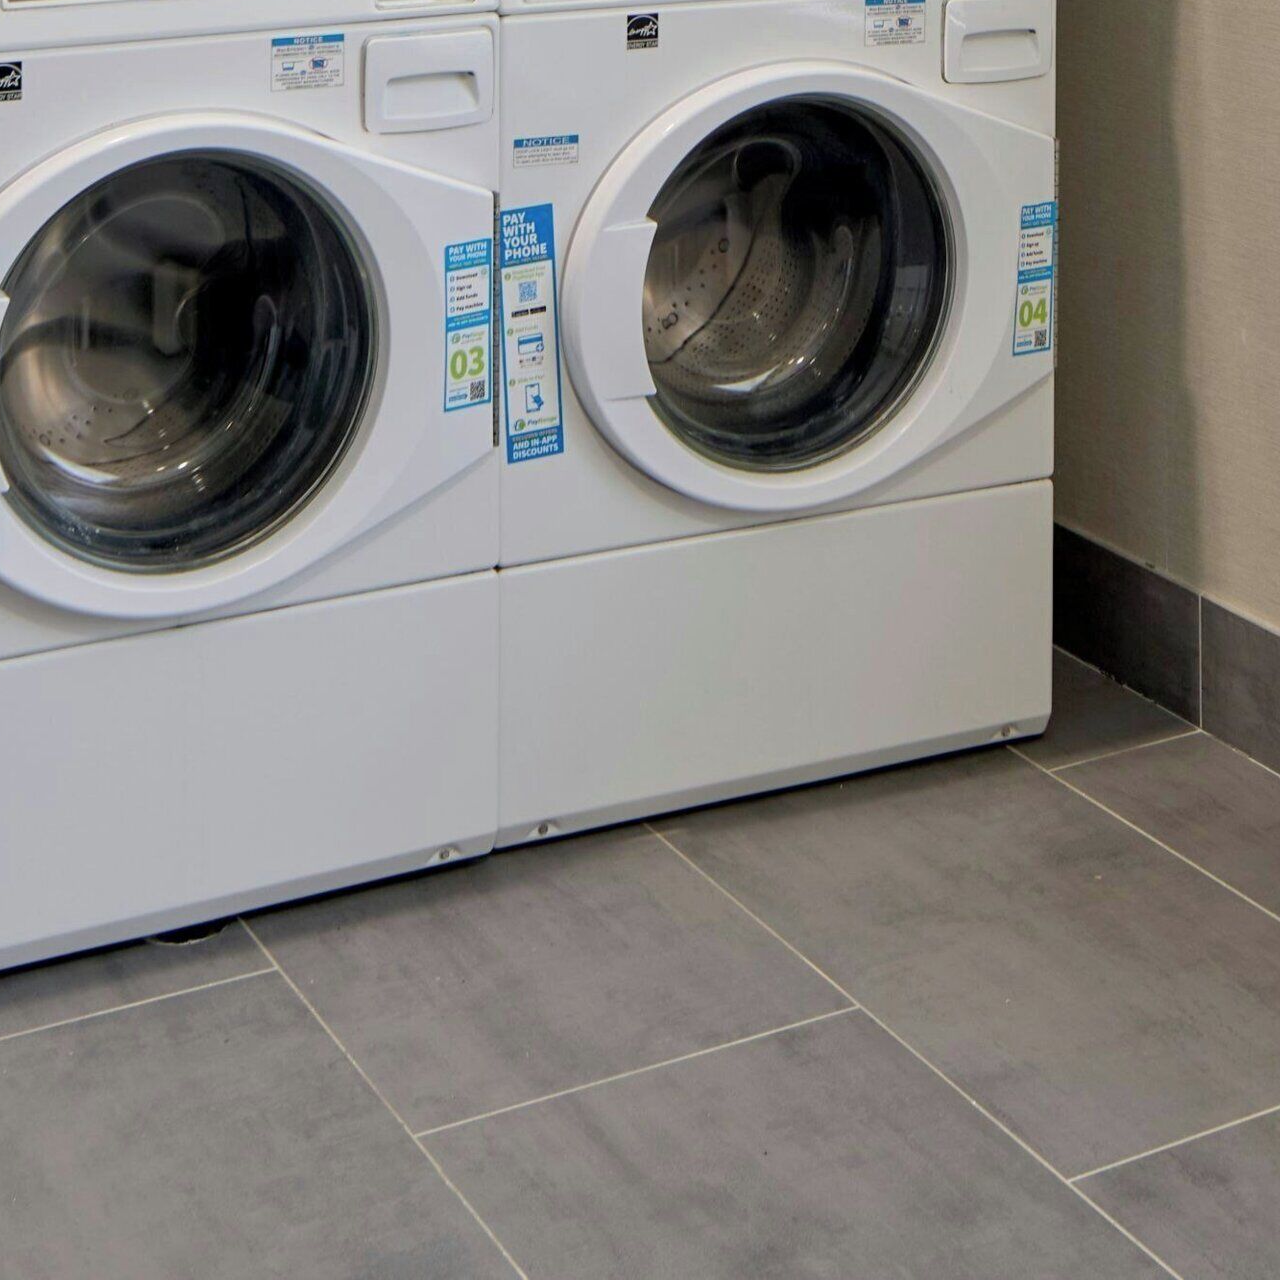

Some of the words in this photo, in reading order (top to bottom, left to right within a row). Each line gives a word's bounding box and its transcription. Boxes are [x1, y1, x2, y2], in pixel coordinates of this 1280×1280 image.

[294, 37, 323, 45] NOTICE
[523, 136, 570, 147] NOTICE
[503, 211, 525, 226] PAY
[503, 222, 535, 237] WITH
[449, 246, 464, 256] PAY
[466, 241, 487, 252] WITH
[504, 233, 537, 249] YOUR
[505, 243, 547, 260] PHONE
[1020, 297, 1047, 327] 04
[450, 346, 484, 380] 03
[513, 440, 529, 451] AND
[532, 435, 558, 446] IN-APP
[513, 443, 558, 459] DISCOUNTS
